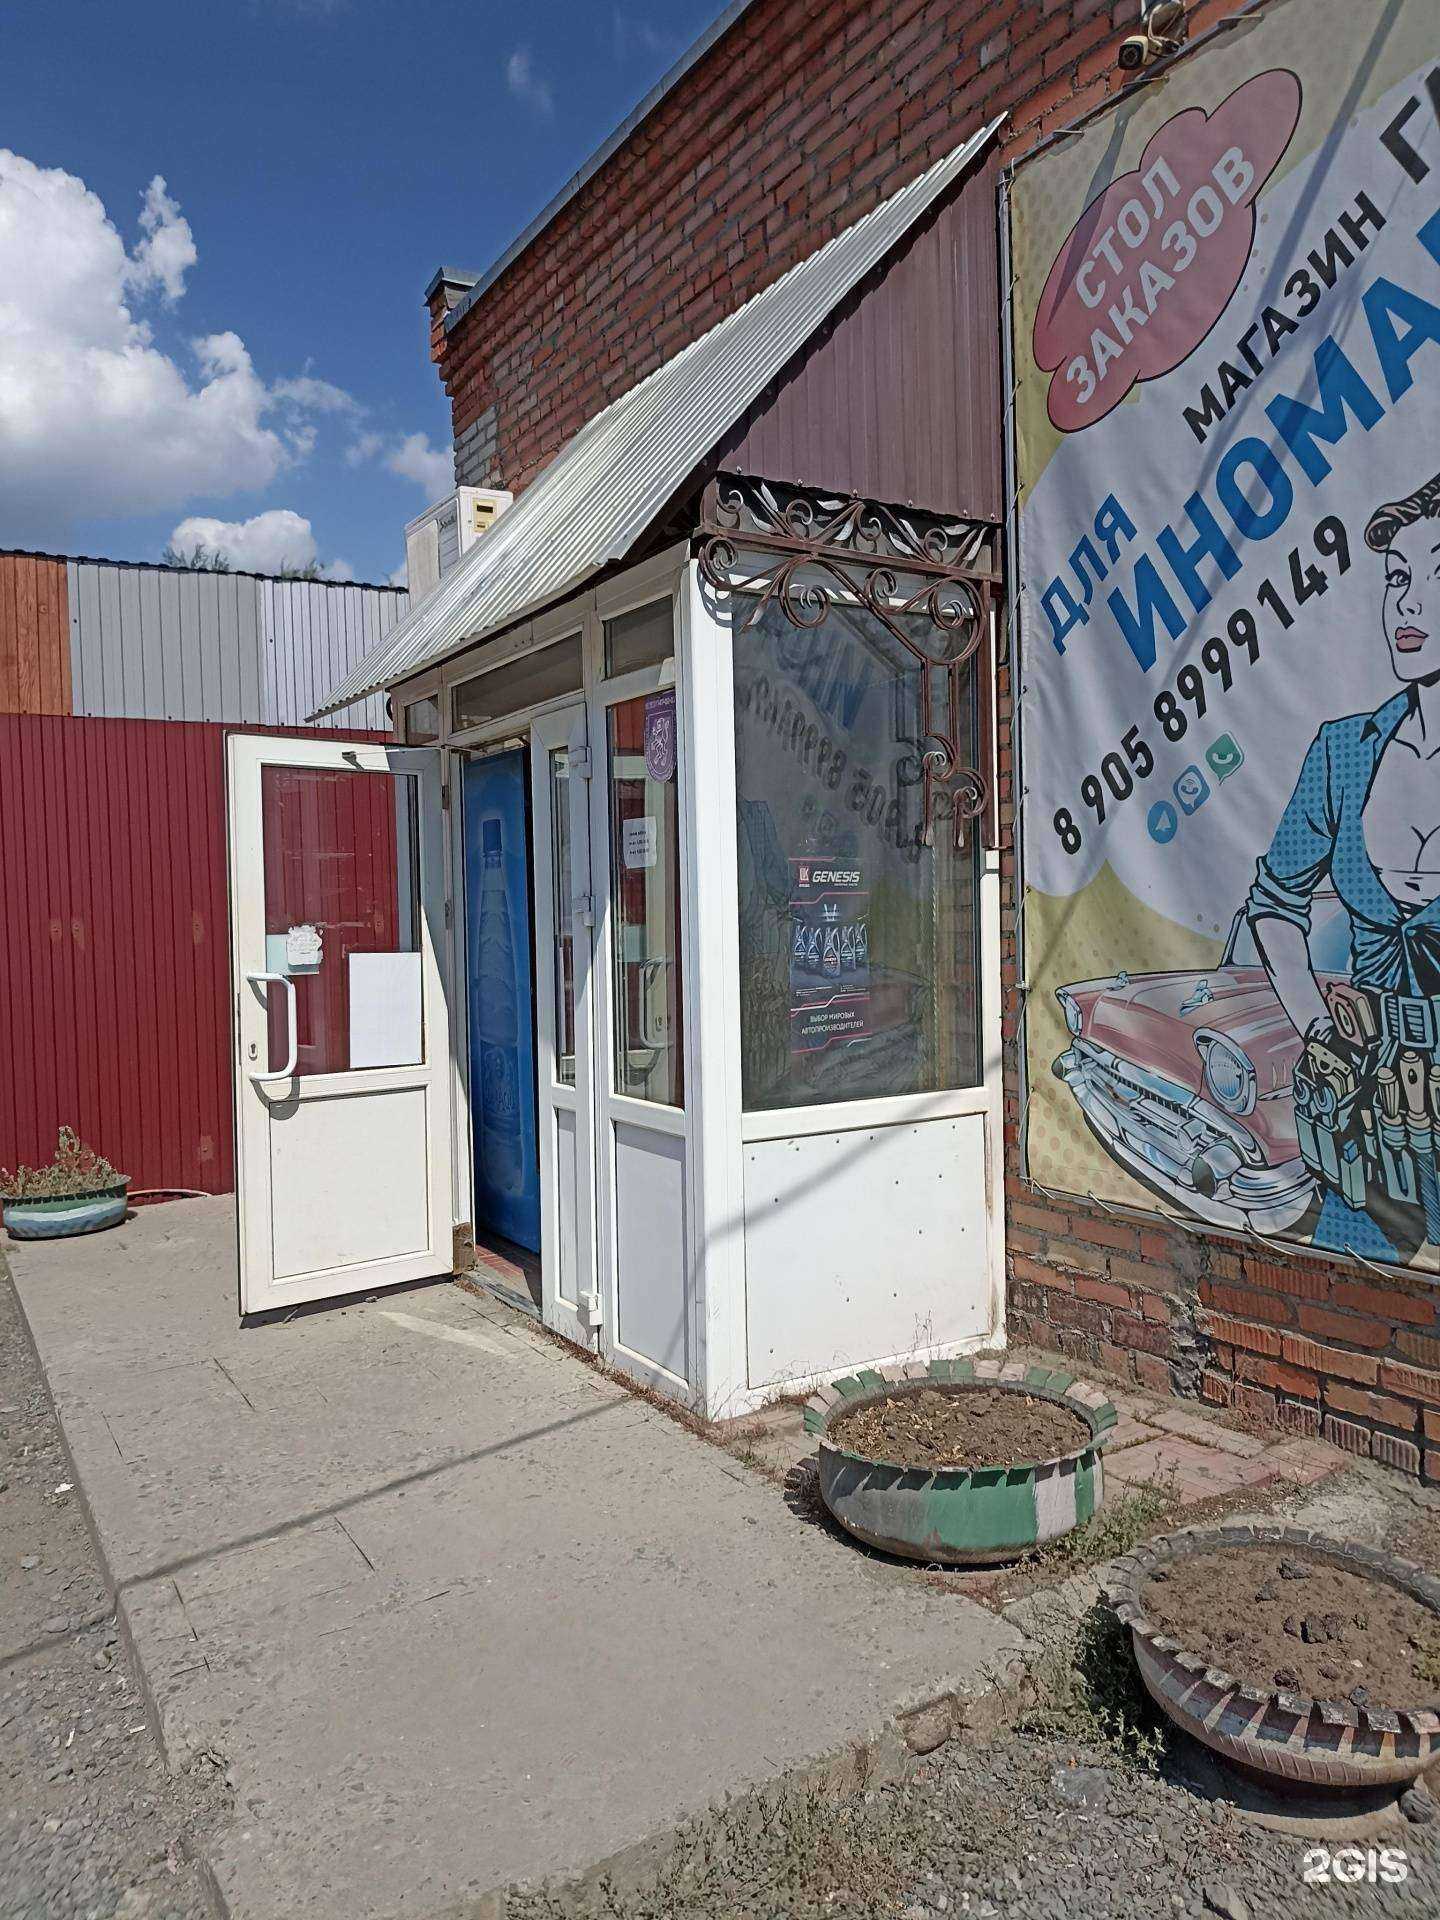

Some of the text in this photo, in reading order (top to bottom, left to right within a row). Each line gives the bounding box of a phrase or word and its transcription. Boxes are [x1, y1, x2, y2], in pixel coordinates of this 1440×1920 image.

[1066, 146, 1255, 403] ЗАКАЗОВ
[1076, 155, 1182, 309] СТОЛ
[1182, 66, 1440, 444] МАГАЗИН Г
[1106, 205, 1440, 674] ИНОМА
[1040, 493, 1138, 656] ДЛЯ
[1053, 515, 1352, 855] 8 905 8999149
[812, 870, 861, 883] GENESIS
